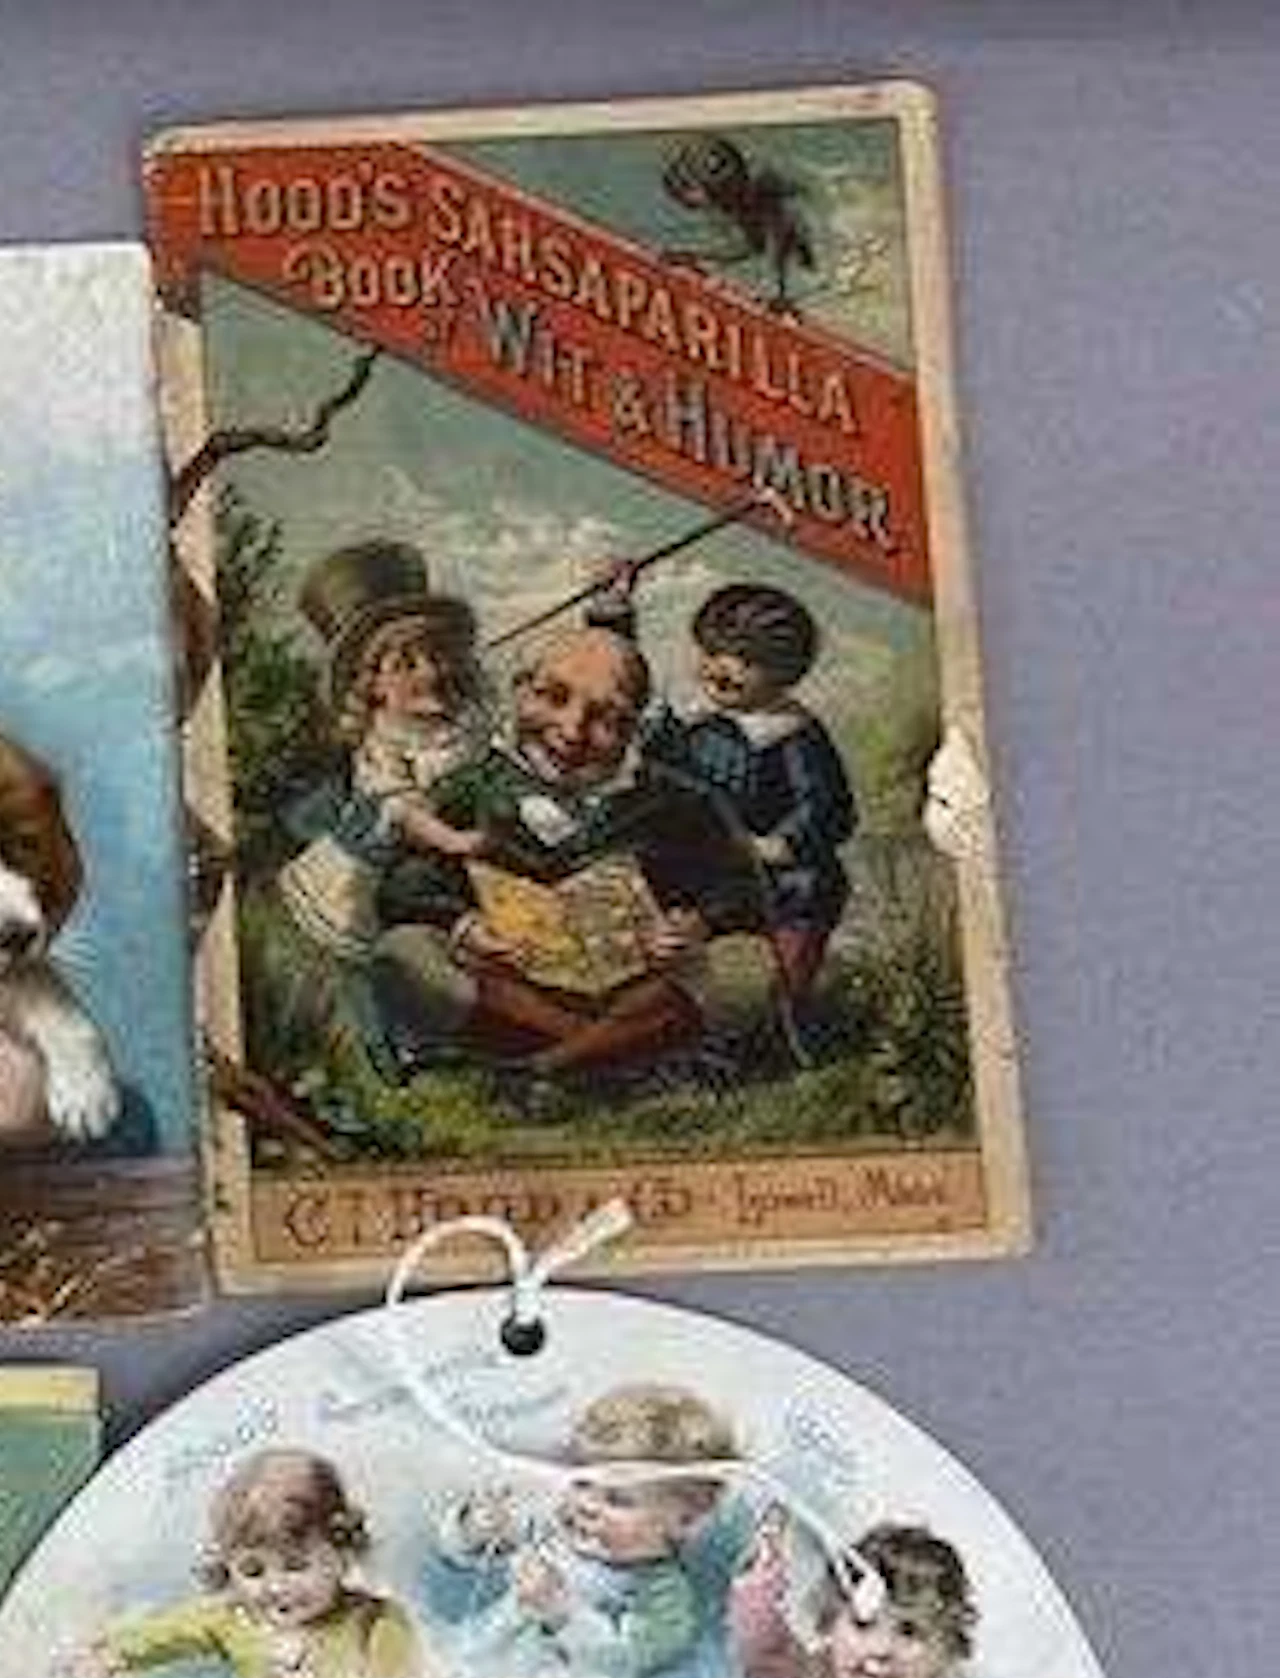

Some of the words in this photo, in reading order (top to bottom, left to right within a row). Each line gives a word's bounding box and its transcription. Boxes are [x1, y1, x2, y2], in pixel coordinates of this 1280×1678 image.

[196, 157, 412, 238] HOOD'S
[429, 185, 864, 434] SARSAPARILLA
[284, 238, 460, 309] BOOK
[478, 297, 594, 404] WIT
[664, 370, 897, 555] HUMOR
